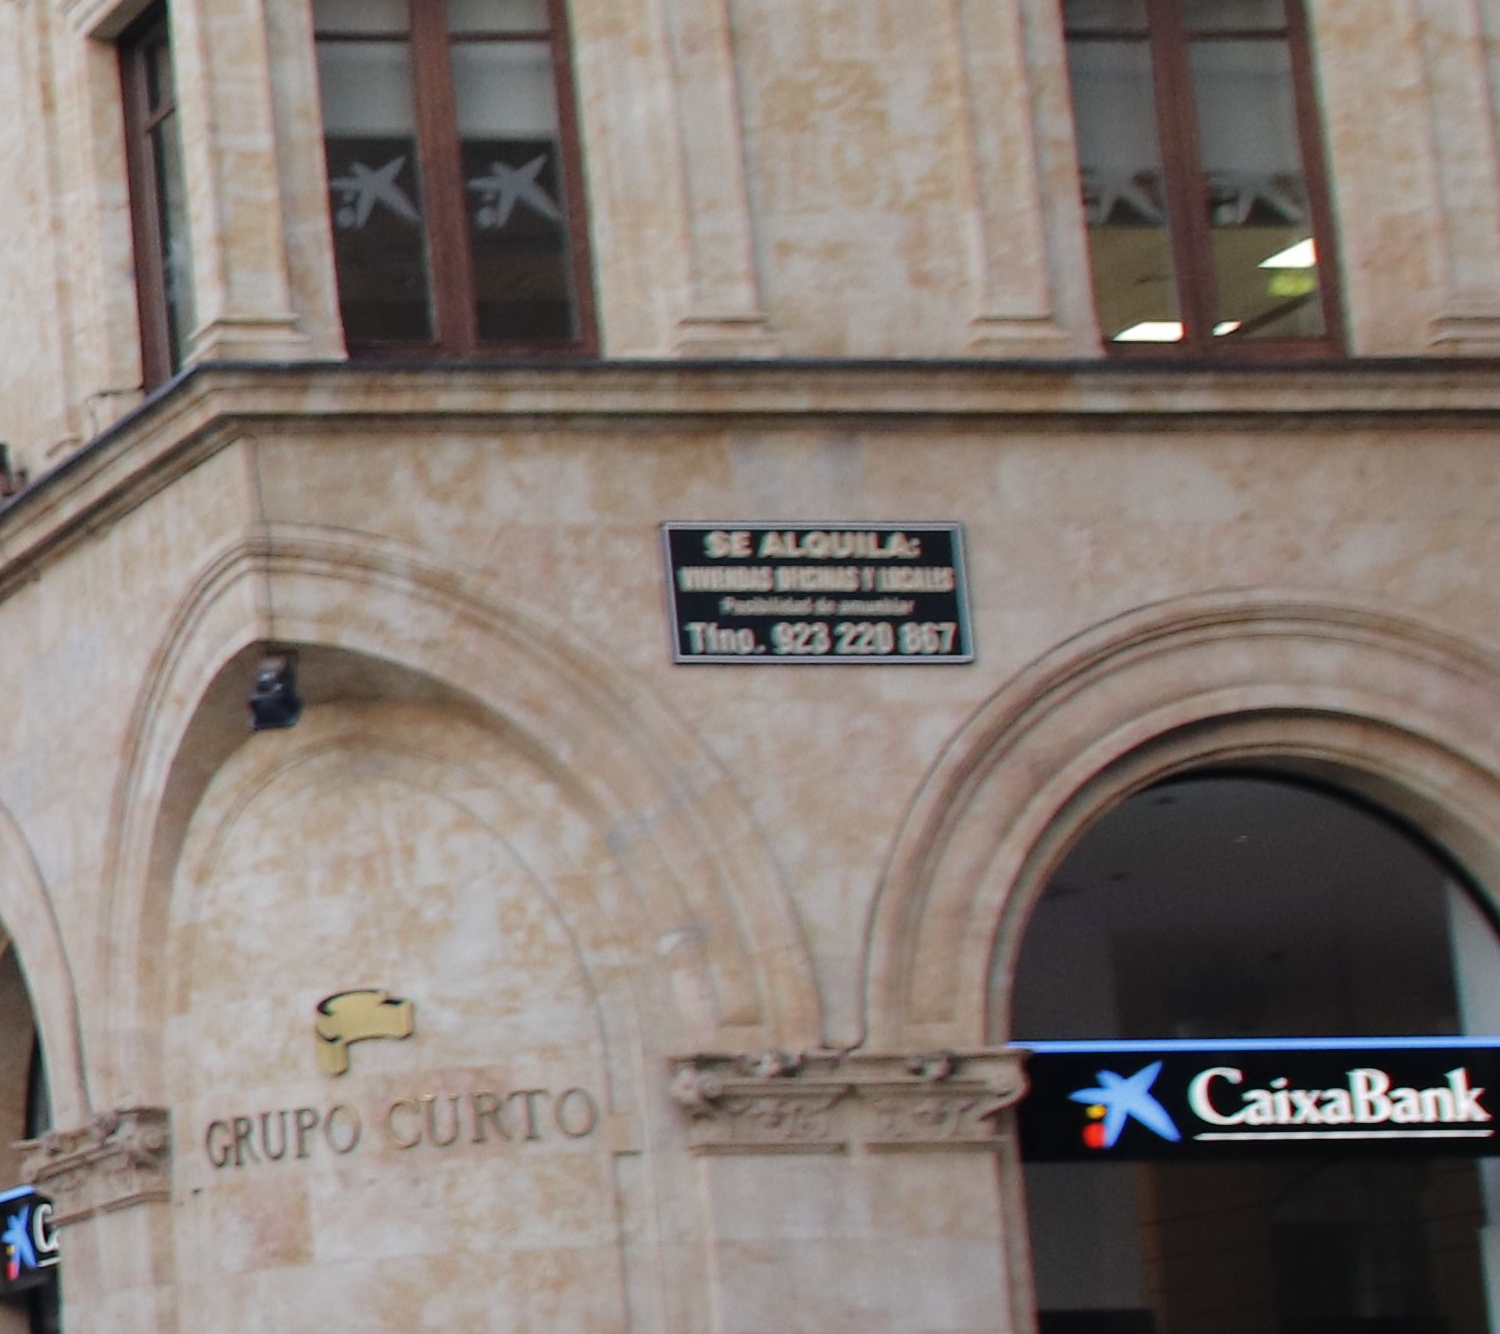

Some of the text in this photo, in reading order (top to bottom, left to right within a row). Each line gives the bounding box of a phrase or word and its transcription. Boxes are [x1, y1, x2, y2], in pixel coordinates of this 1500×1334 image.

[703, 531, 922, 559] SE ALQUILA:
[677, 566, 955, 593] VIVIENDAS OFICINAS Y LOCALES
[684, 621, 957, 655] Tfno. 923 220 867
[1187, 1066, 1492, 1126] CaixaBank
[204, 1087, 599, 1168] GRUPO CURTO
